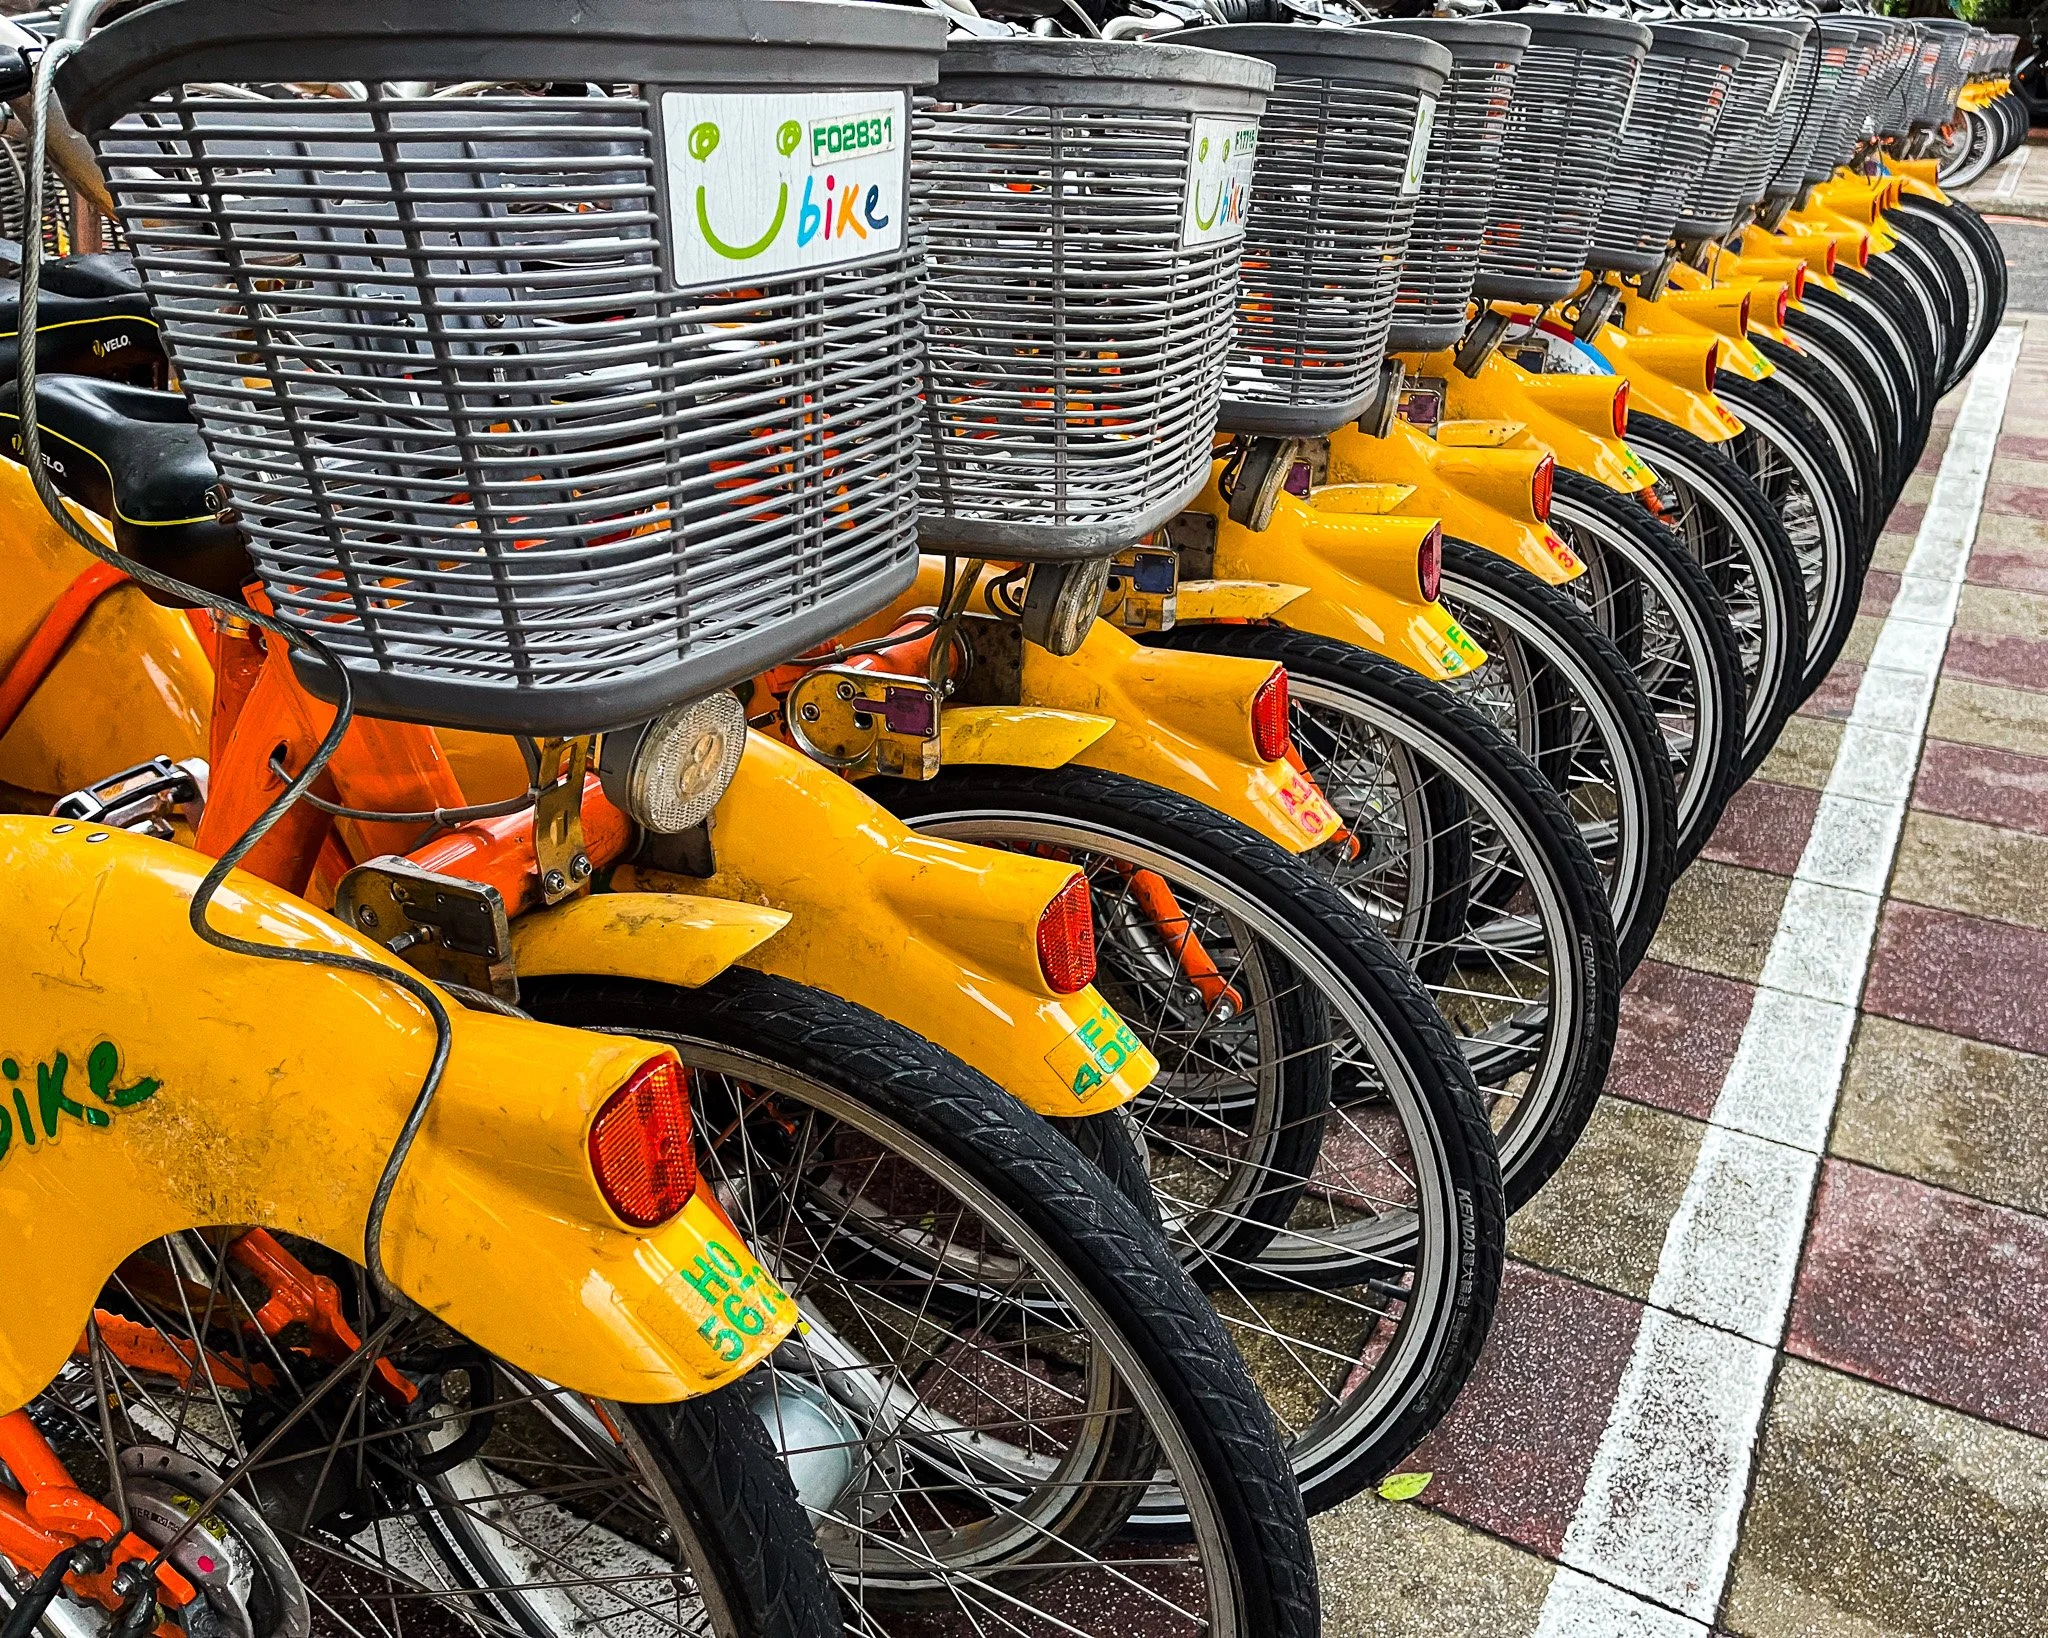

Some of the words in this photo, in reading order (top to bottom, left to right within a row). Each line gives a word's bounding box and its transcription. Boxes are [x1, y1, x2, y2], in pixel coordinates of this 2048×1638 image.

[103, 335, 129, 353] VELO
[40, 452, 65, 474] ELO
[1580, 933, 1597, 990] KENDA
[1456, 1187, 1477, 1251] KENDA
